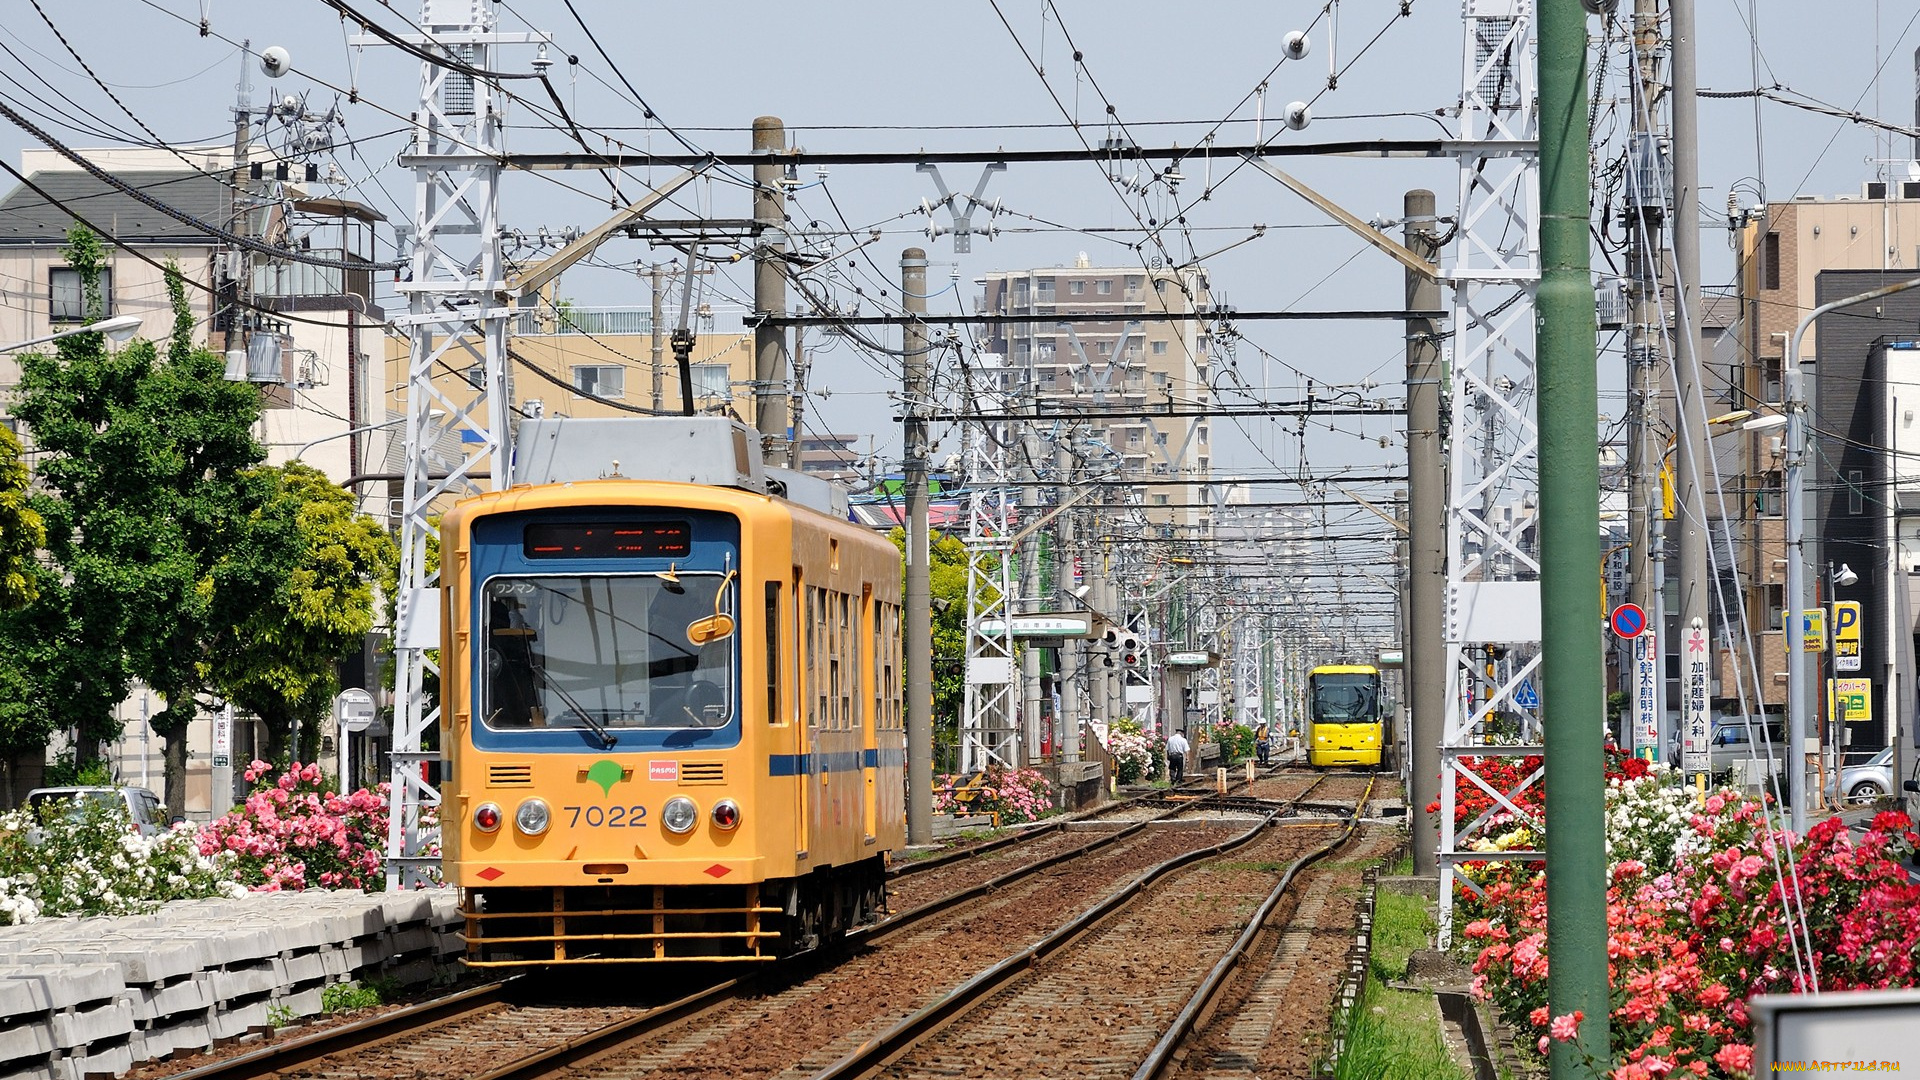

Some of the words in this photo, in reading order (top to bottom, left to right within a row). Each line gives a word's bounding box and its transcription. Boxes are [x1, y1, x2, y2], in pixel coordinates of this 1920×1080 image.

[496, 583, 536, 595] ワンマン
[1835, 608, 1857, 636] P
[1838, 681, 1867, 692] イクパーク
[1691, 661, 1705, 738] 加藤産婦人科
[563, 806, 647, 828] 7022
